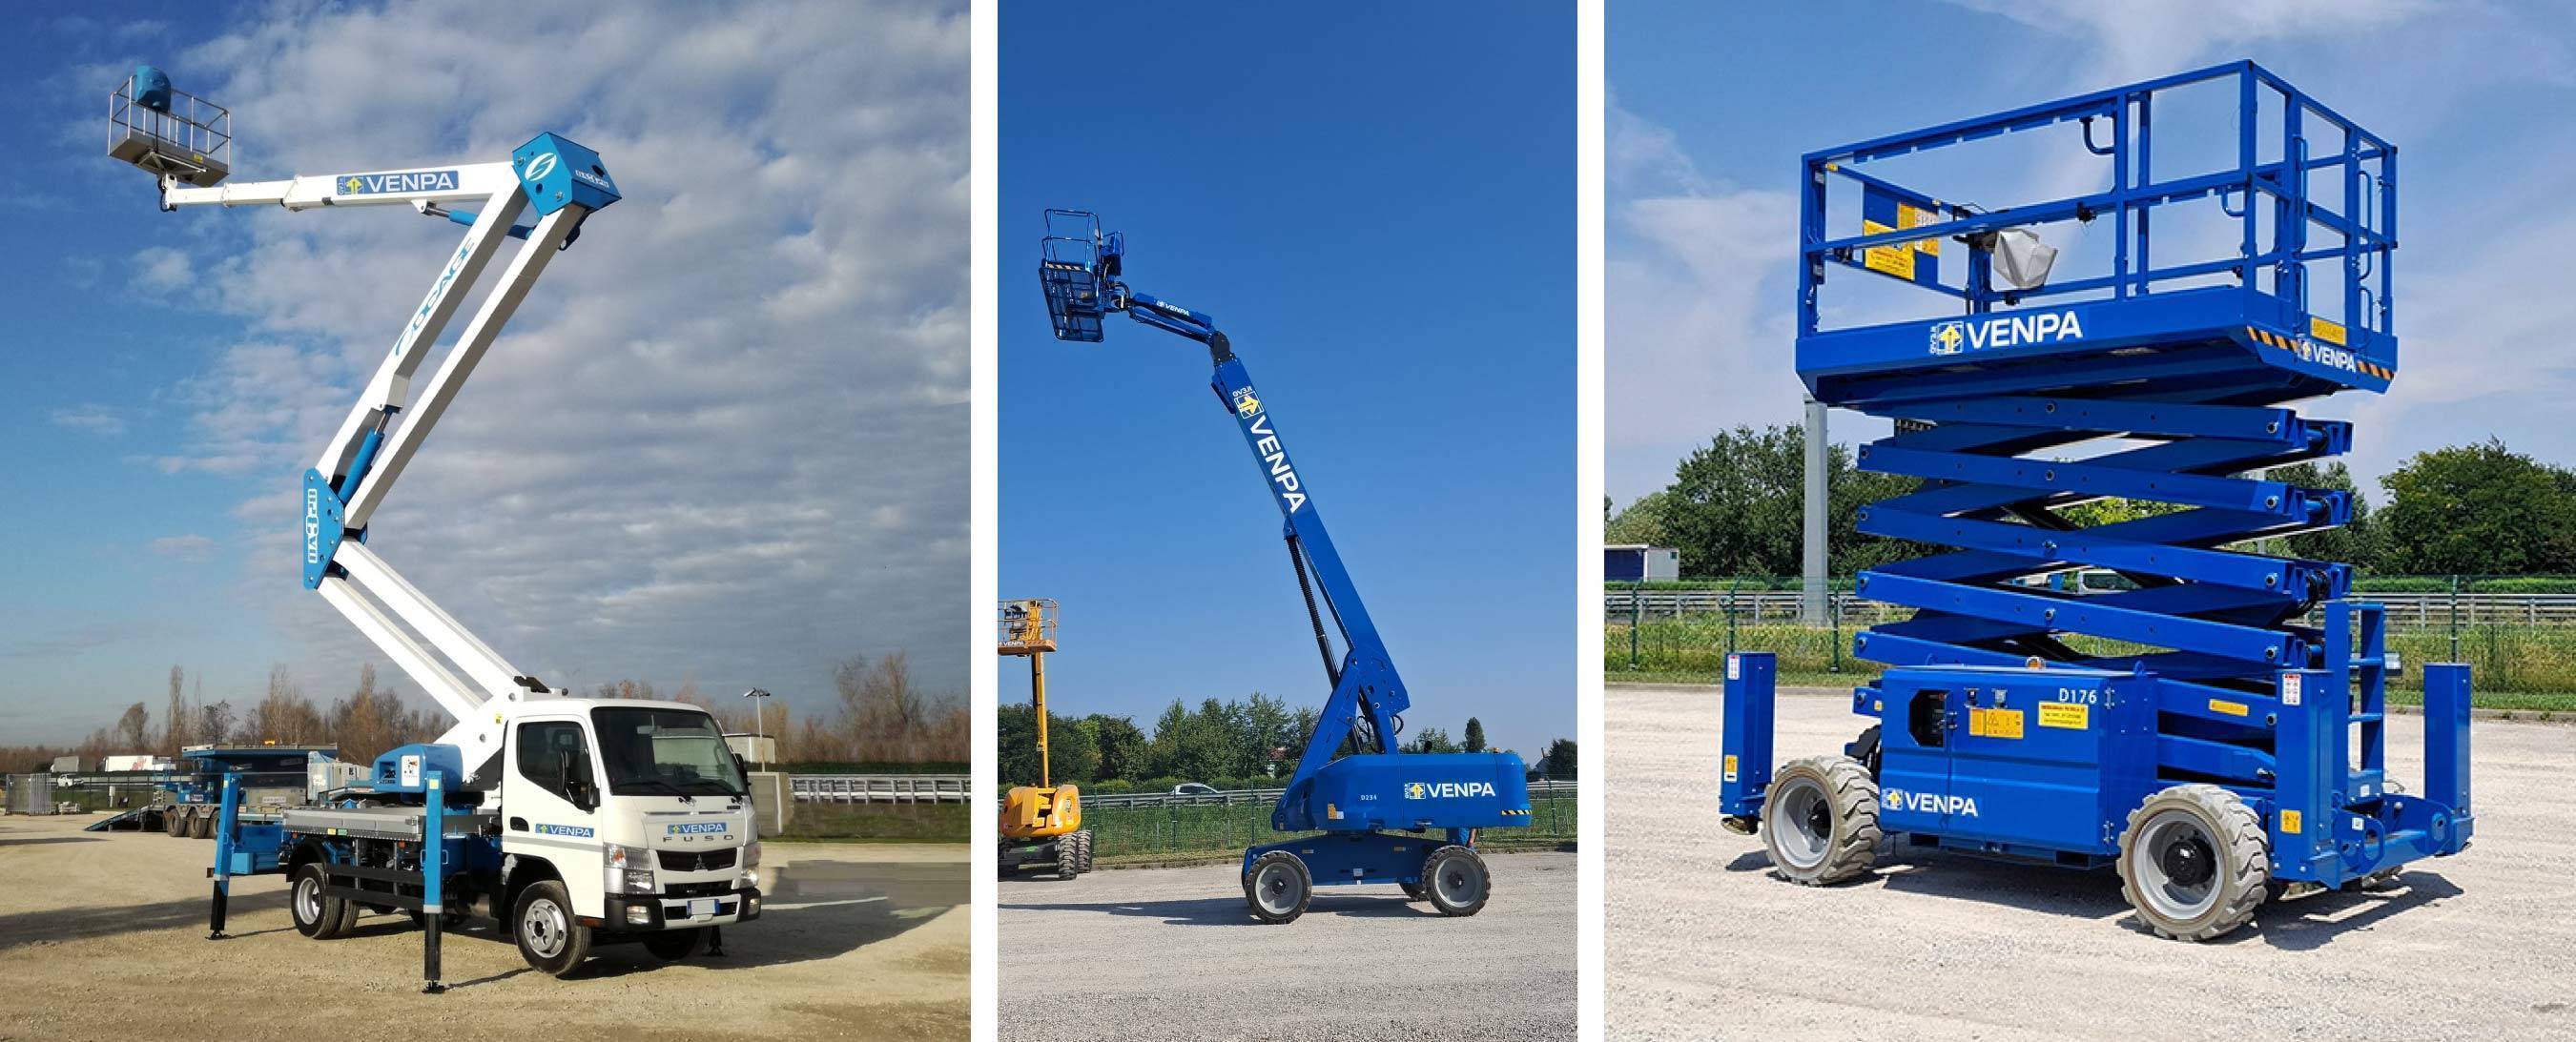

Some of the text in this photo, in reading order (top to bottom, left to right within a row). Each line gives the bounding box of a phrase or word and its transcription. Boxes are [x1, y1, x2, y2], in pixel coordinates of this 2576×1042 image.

[366, 173, 454, 193] VENPA
[1165, 303, 1190, 317] VENPA
[1966, 310, 2083, 350] VENPA
[2313, 343, 2357, 374] VENPA
[1250, 415, 1307, 514] VENPA
[2059, 687, 2097, 704] D176
[1427, 782, 1495, 798] VENPA
[1905, 791, 1979, 817] VENPA
[549, 826, 591, 838] VENPA
[682, 823, 724, 833] VENPA
[662, 834, 733, 843] FUSO
